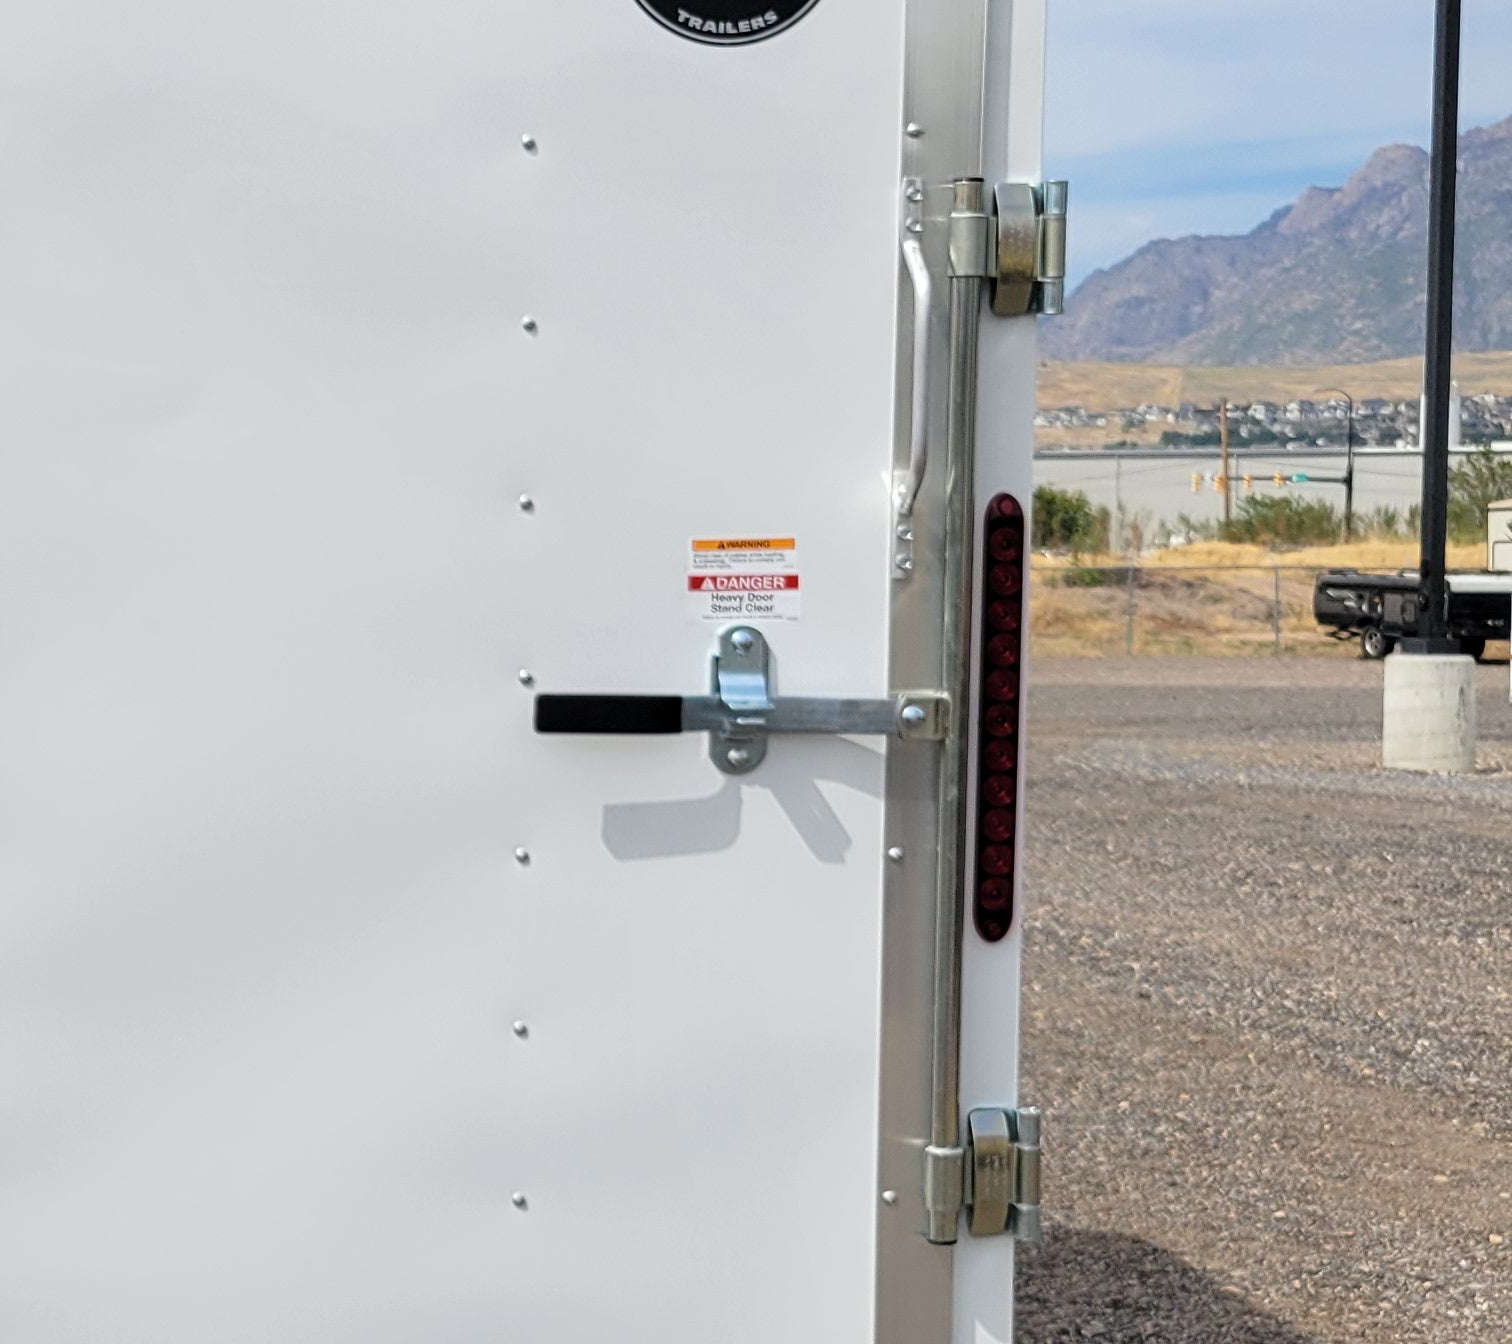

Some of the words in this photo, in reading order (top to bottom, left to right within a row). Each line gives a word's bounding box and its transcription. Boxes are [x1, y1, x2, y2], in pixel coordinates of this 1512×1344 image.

[677, 8, 779, 35] TRAILERS
[727, 540, 771, 549] WARNING
[716, 576, 786, 590] DANGER
[710, 593, 744, 605] Heavy
[748, 593, 774, 602] Door
[710, 603, 742, 613] Stand
[745, 604, 774, 613] Clear
